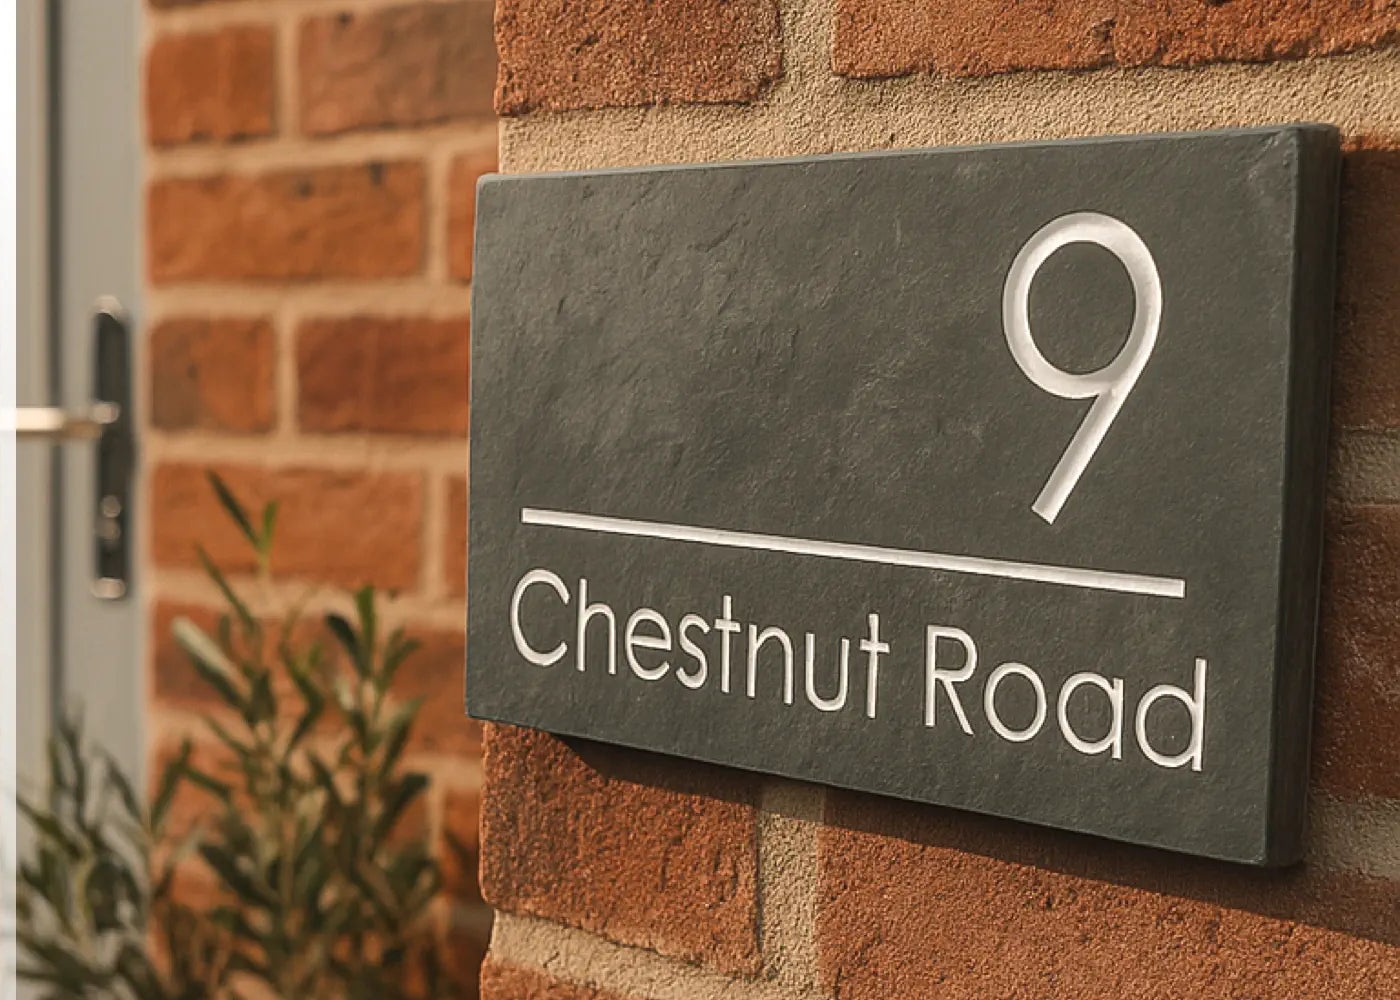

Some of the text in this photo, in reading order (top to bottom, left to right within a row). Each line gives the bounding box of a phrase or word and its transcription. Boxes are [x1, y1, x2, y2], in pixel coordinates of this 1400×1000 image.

[1001, 212, 1163, 525] 9
[509, 568, 1208, 773] Chestnut Road
